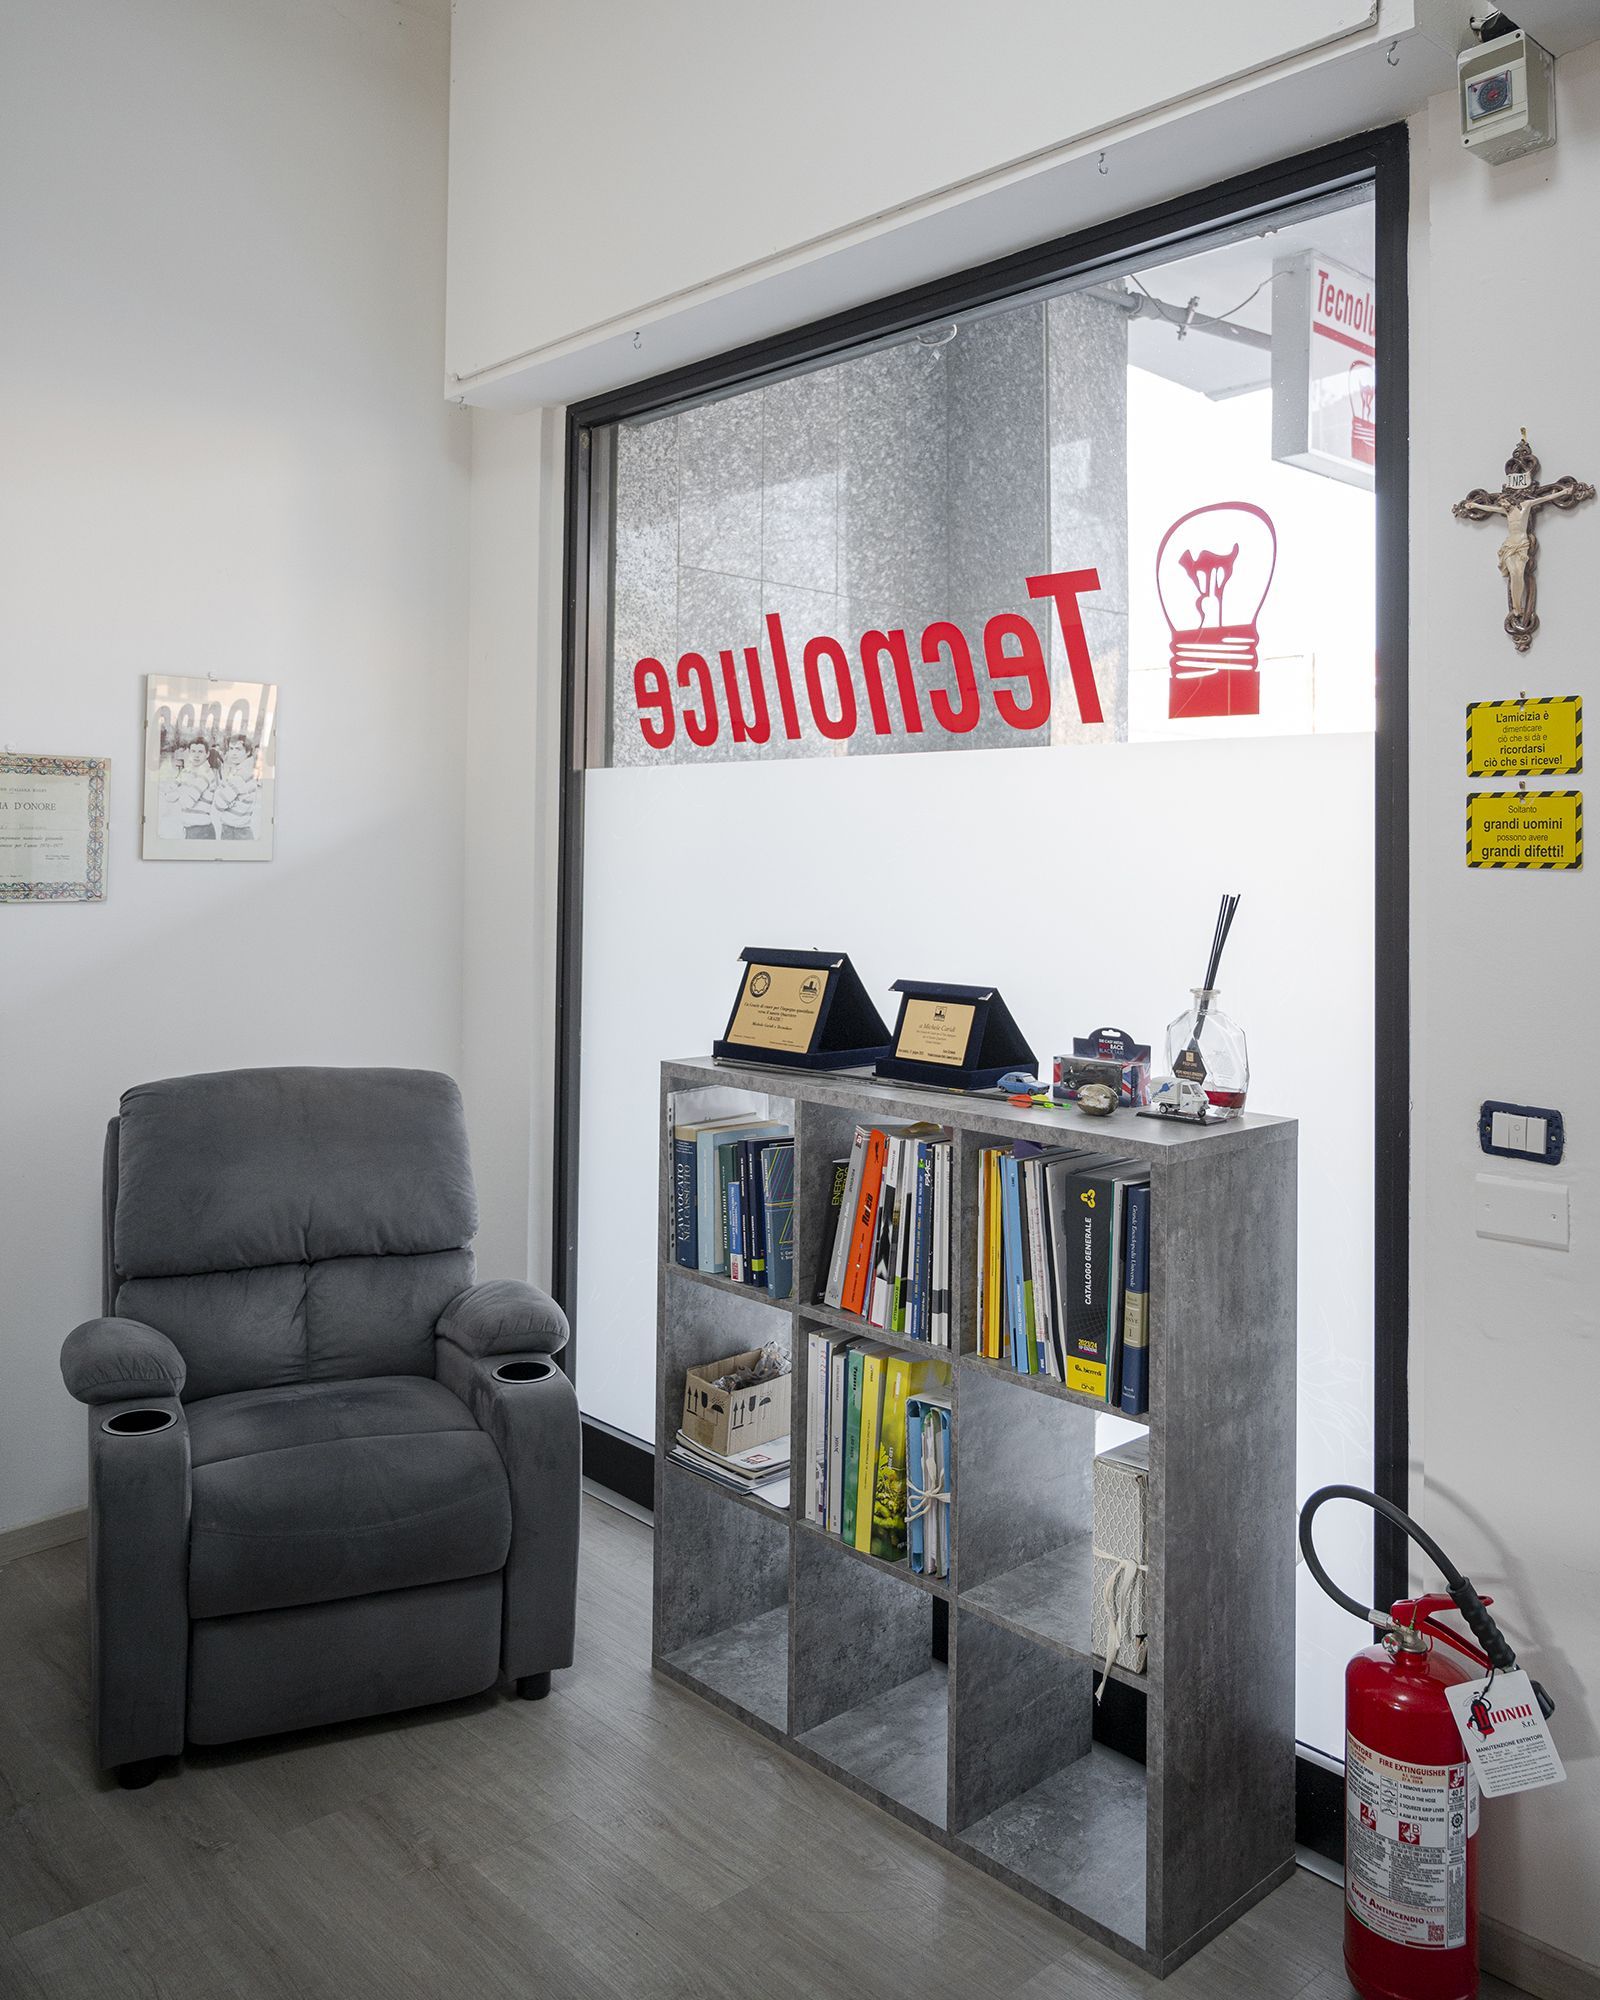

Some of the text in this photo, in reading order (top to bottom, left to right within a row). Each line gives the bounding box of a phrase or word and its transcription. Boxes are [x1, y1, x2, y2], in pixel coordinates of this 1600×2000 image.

[1507, 474, 1527, 487] INRI
[1496, 713, 1541, 723] L'amicizia
[1502, 724, 1542, 734] dimenticare
[1509, 734, 1523, 742] che
[1524, 733, 1531, 742] si
[1500, 743, 1545, 755] ricordarsi
[1483, 754, 1563, 768] ciò che si riceve!
[14, 801, 57, 811] D'ONORE
[1508, 805, 1537, 814] Soltanto
[1483, 818, 1563, 832] grandi uomini
[1496, 833, 1548, 842] possono avere
[1481, 845, 1564, 860] grandi difetti!
[831, 1166, 843, 1206] ENERGY
[677, 1163, 685, 1241] L'AVVOCATO
[1084, 1217, 1092, 1305] CATALOGO GENERALE
[1475, 1739, 1516, 1754] MANUTENZIONE
[1378, 1757, 1393, 1769] FIRE
[1394, 1762, 1446, 1777] EXTINGUISHER
[1403, 1784, 1421, 1792] REMOVE
[1402, 1803, 1421, 1812] SQUEEZE
[1370, 1810, 1377, 1819] A
[1412, 1824, 1420, 1834] B
[1369, 1898, 1425, 1924] ANTINCENDIO
